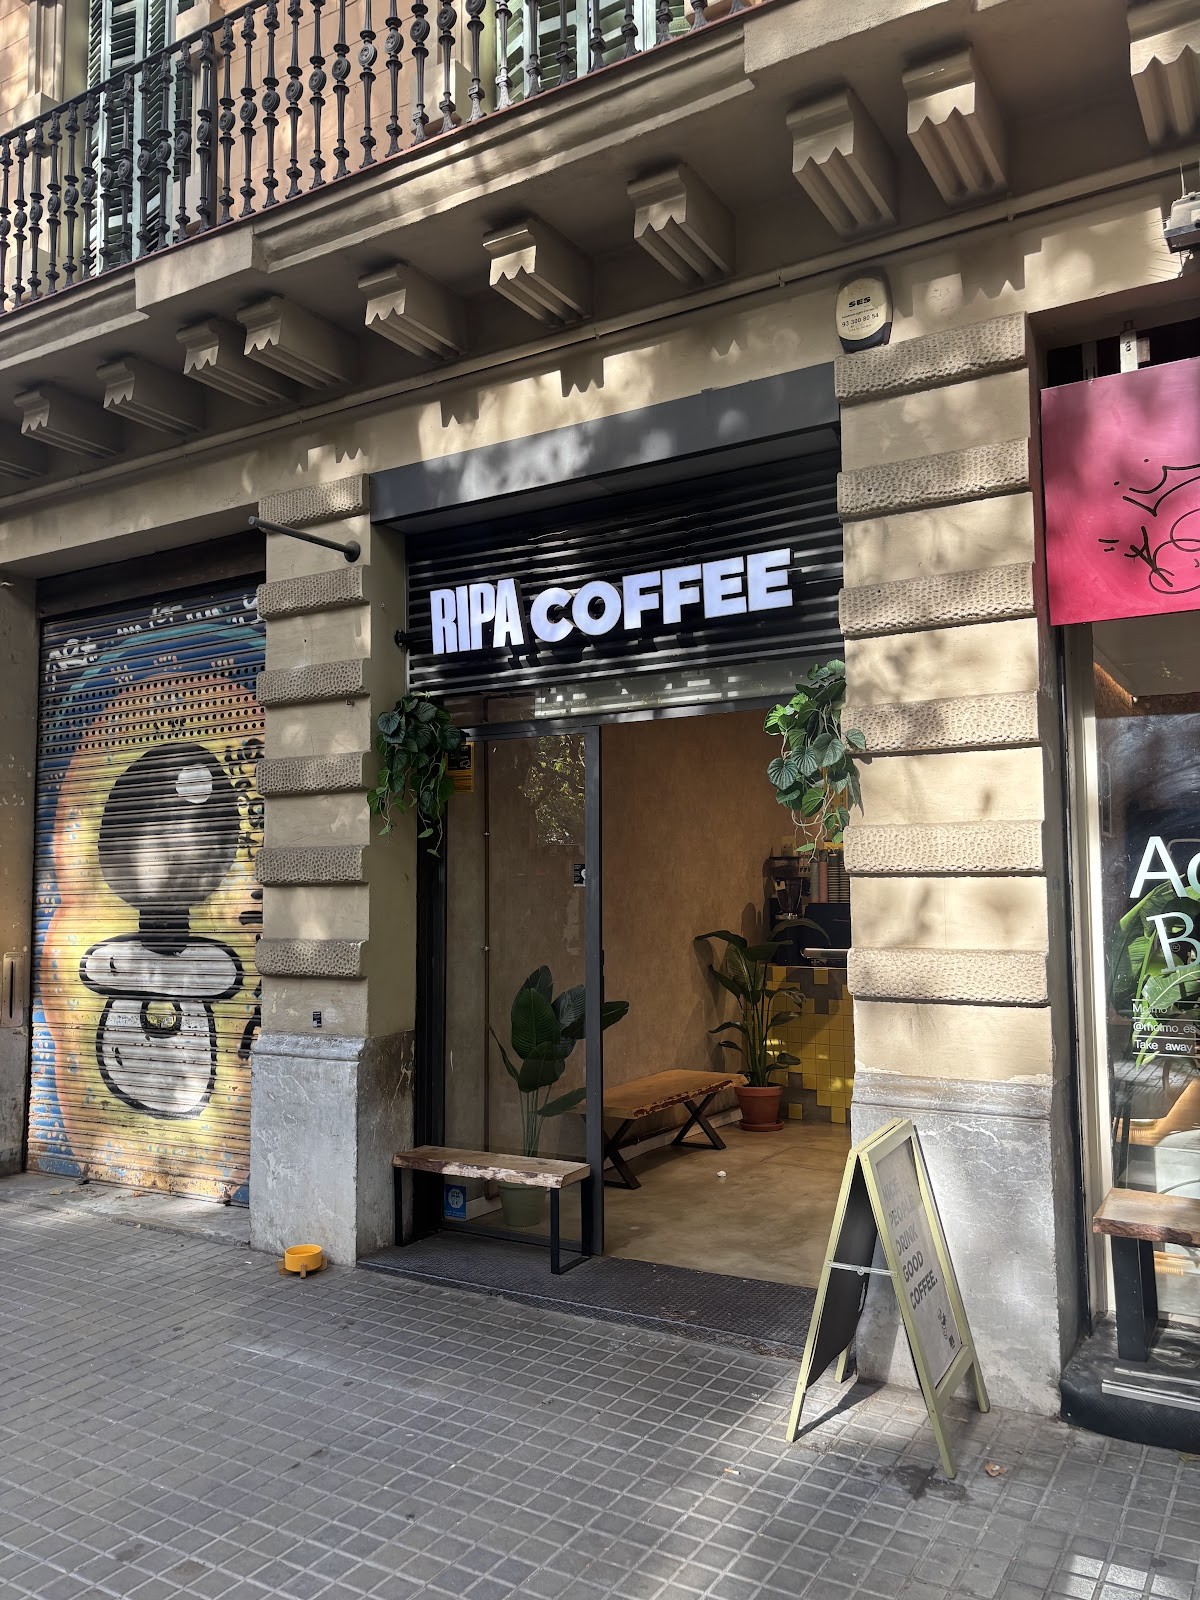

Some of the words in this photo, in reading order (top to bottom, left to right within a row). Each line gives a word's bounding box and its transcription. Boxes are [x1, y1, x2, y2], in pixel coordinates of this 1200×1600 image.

[848, 296, 871, 308] SES
[430, 578, 526, 656] RIPA
[530, 547, 794, 643] COFFEE
[1134, 1040, 1159, 1050] Take
[1165, 1042, 1193, 1054] away
[896, 1224, 919, 1257] DRINK
[902, 1250, 924, 1283] GOOD
[909, 1269, 938, 1310] COFFEE.
